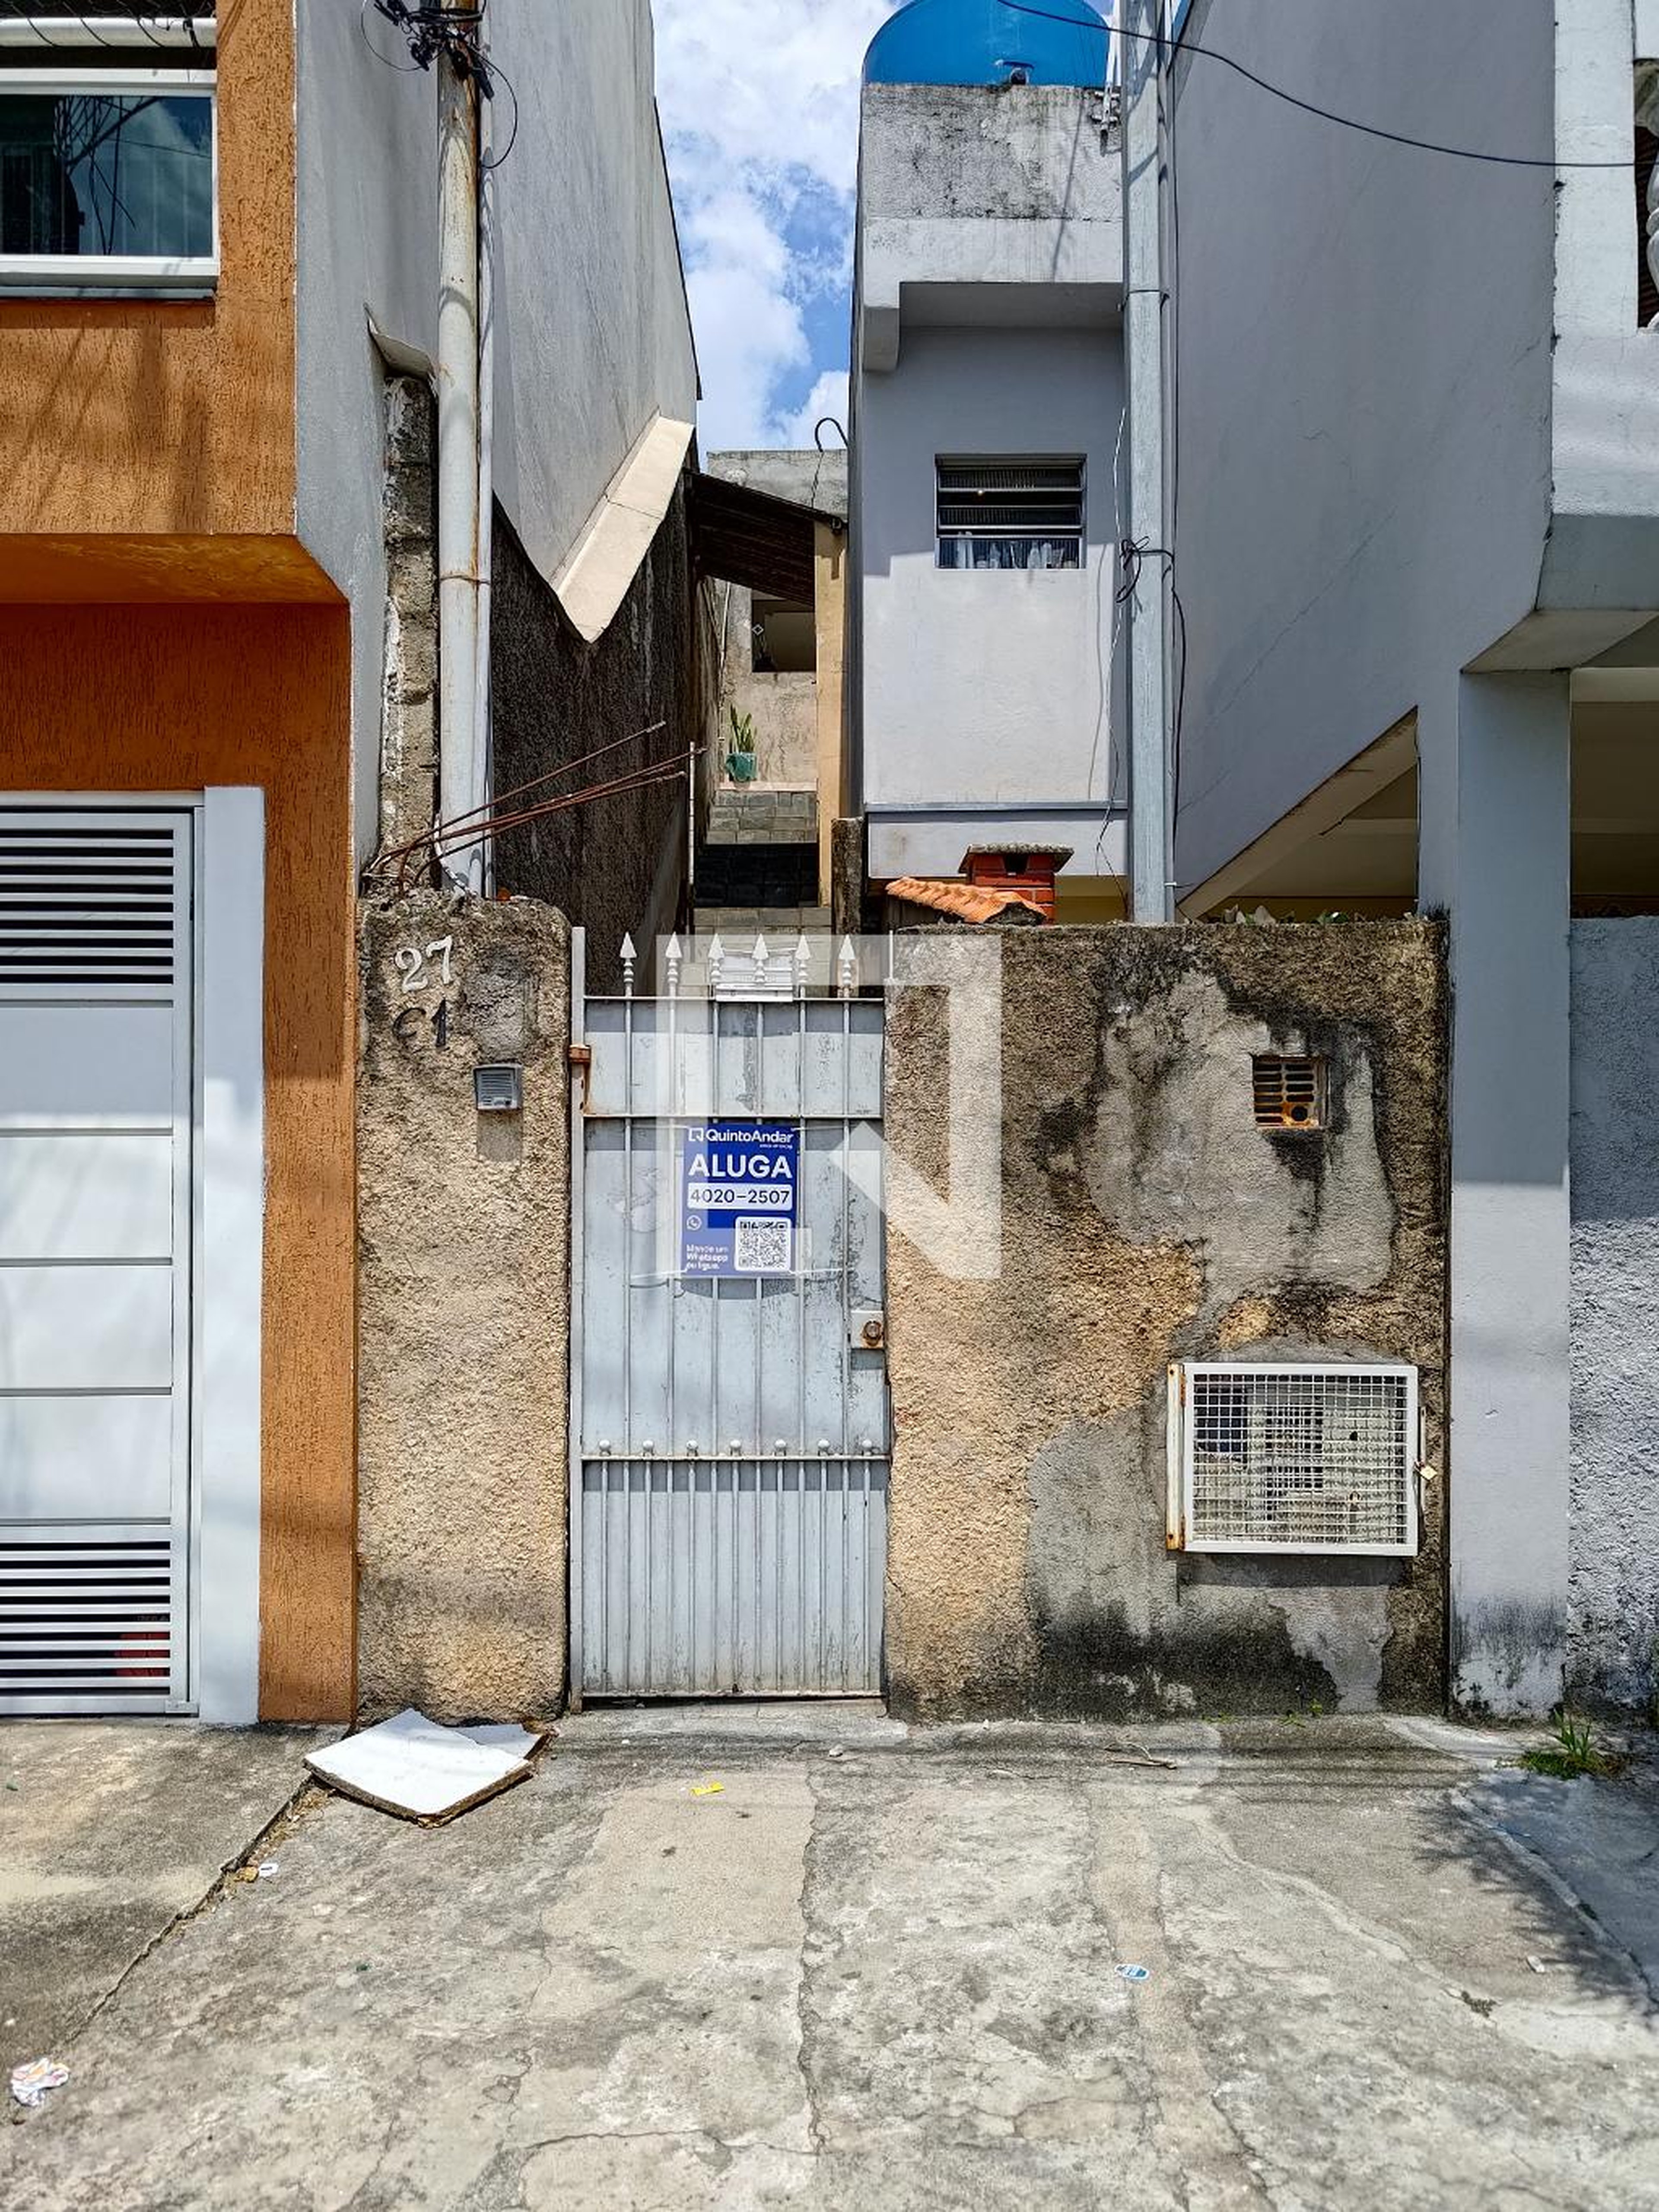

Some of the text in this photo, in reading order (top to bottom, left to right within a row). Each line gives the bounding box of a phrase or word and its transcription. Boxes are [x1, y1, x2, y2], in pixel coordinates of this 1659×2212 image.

[394, 934, 452, 993] 27
[706, 1129, 794, 1143] QuintoAndar
[688, 1154, 793, 1178] ALUGA
[690, 1188, 790, 1204] 4020-2507
